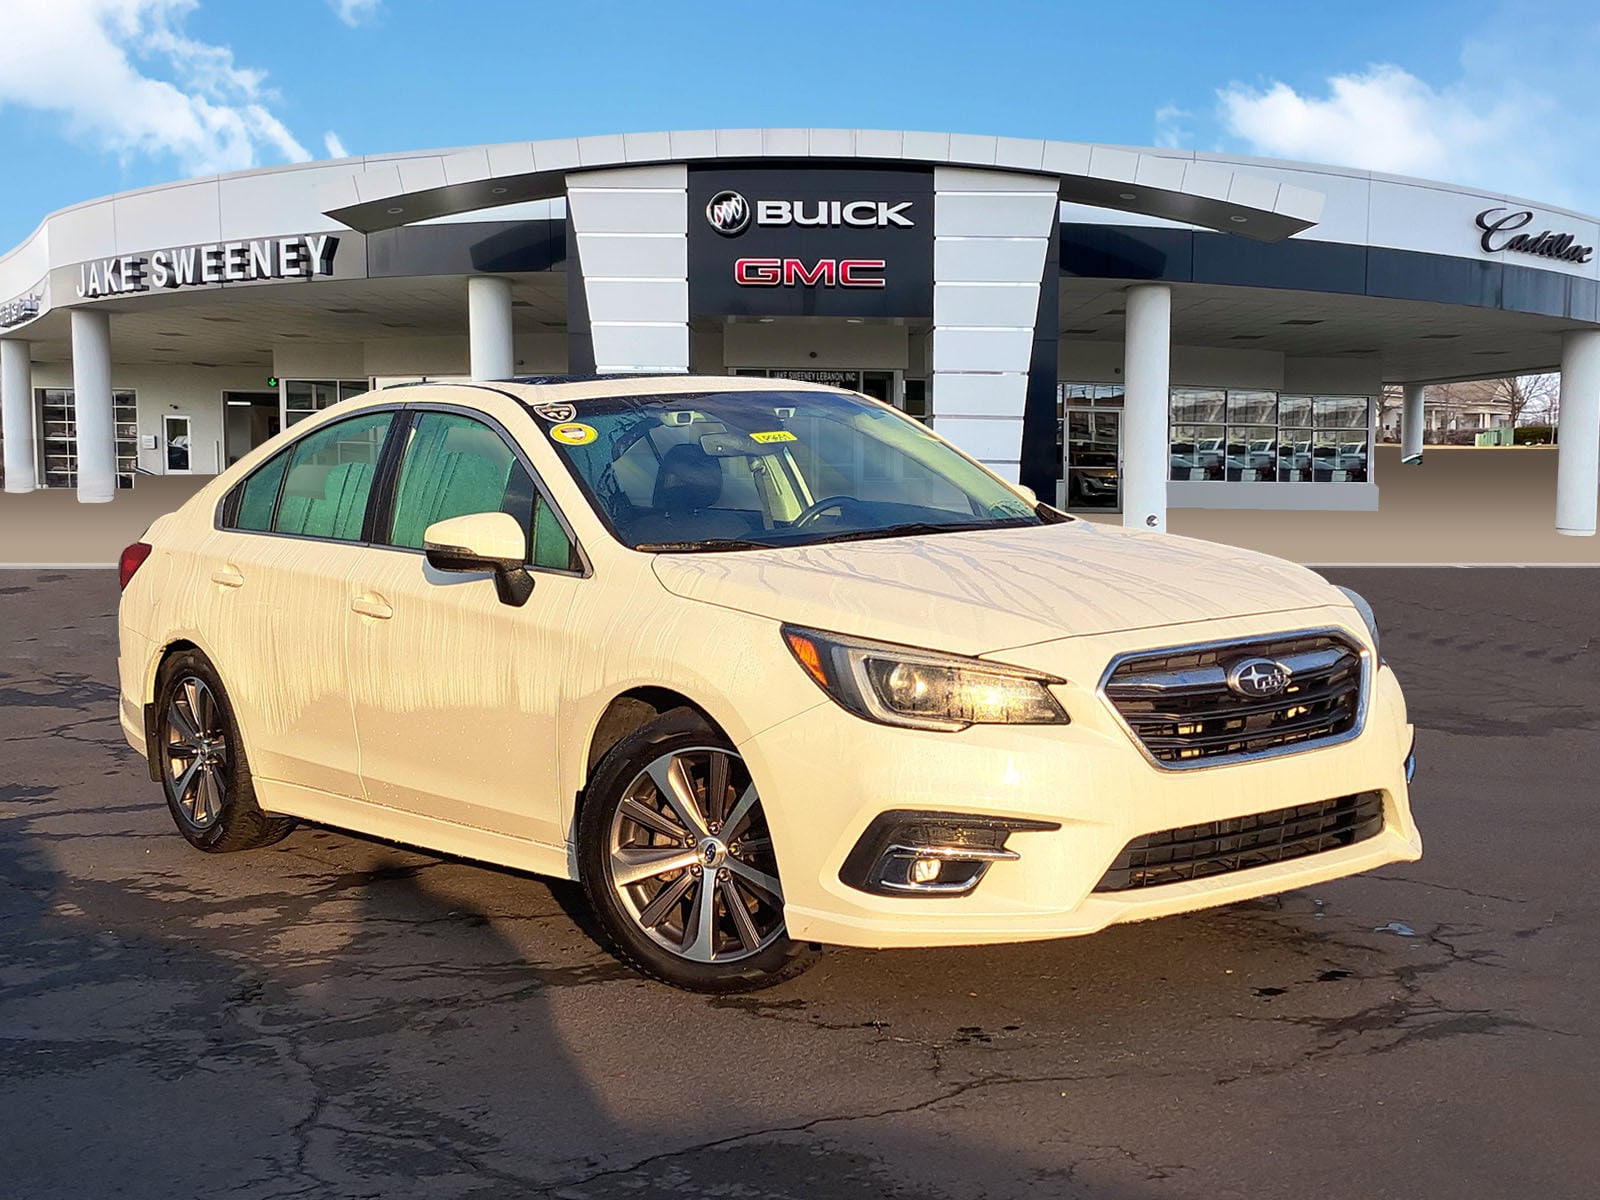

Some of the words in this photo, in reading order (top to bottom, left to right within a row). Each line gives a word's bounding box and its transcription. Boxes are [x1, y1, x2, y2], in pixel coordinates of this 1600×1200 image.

[757, 200, 915, 226] BUICK
[1475, 207, 1594, 264] Cadillac
[76, 255, 143, 297] JAKE
[151, 234, 335, 288] SWEENEY
[734, 258, 886, 287] GMC
[788, 371, 815, 380] SWEENEY
